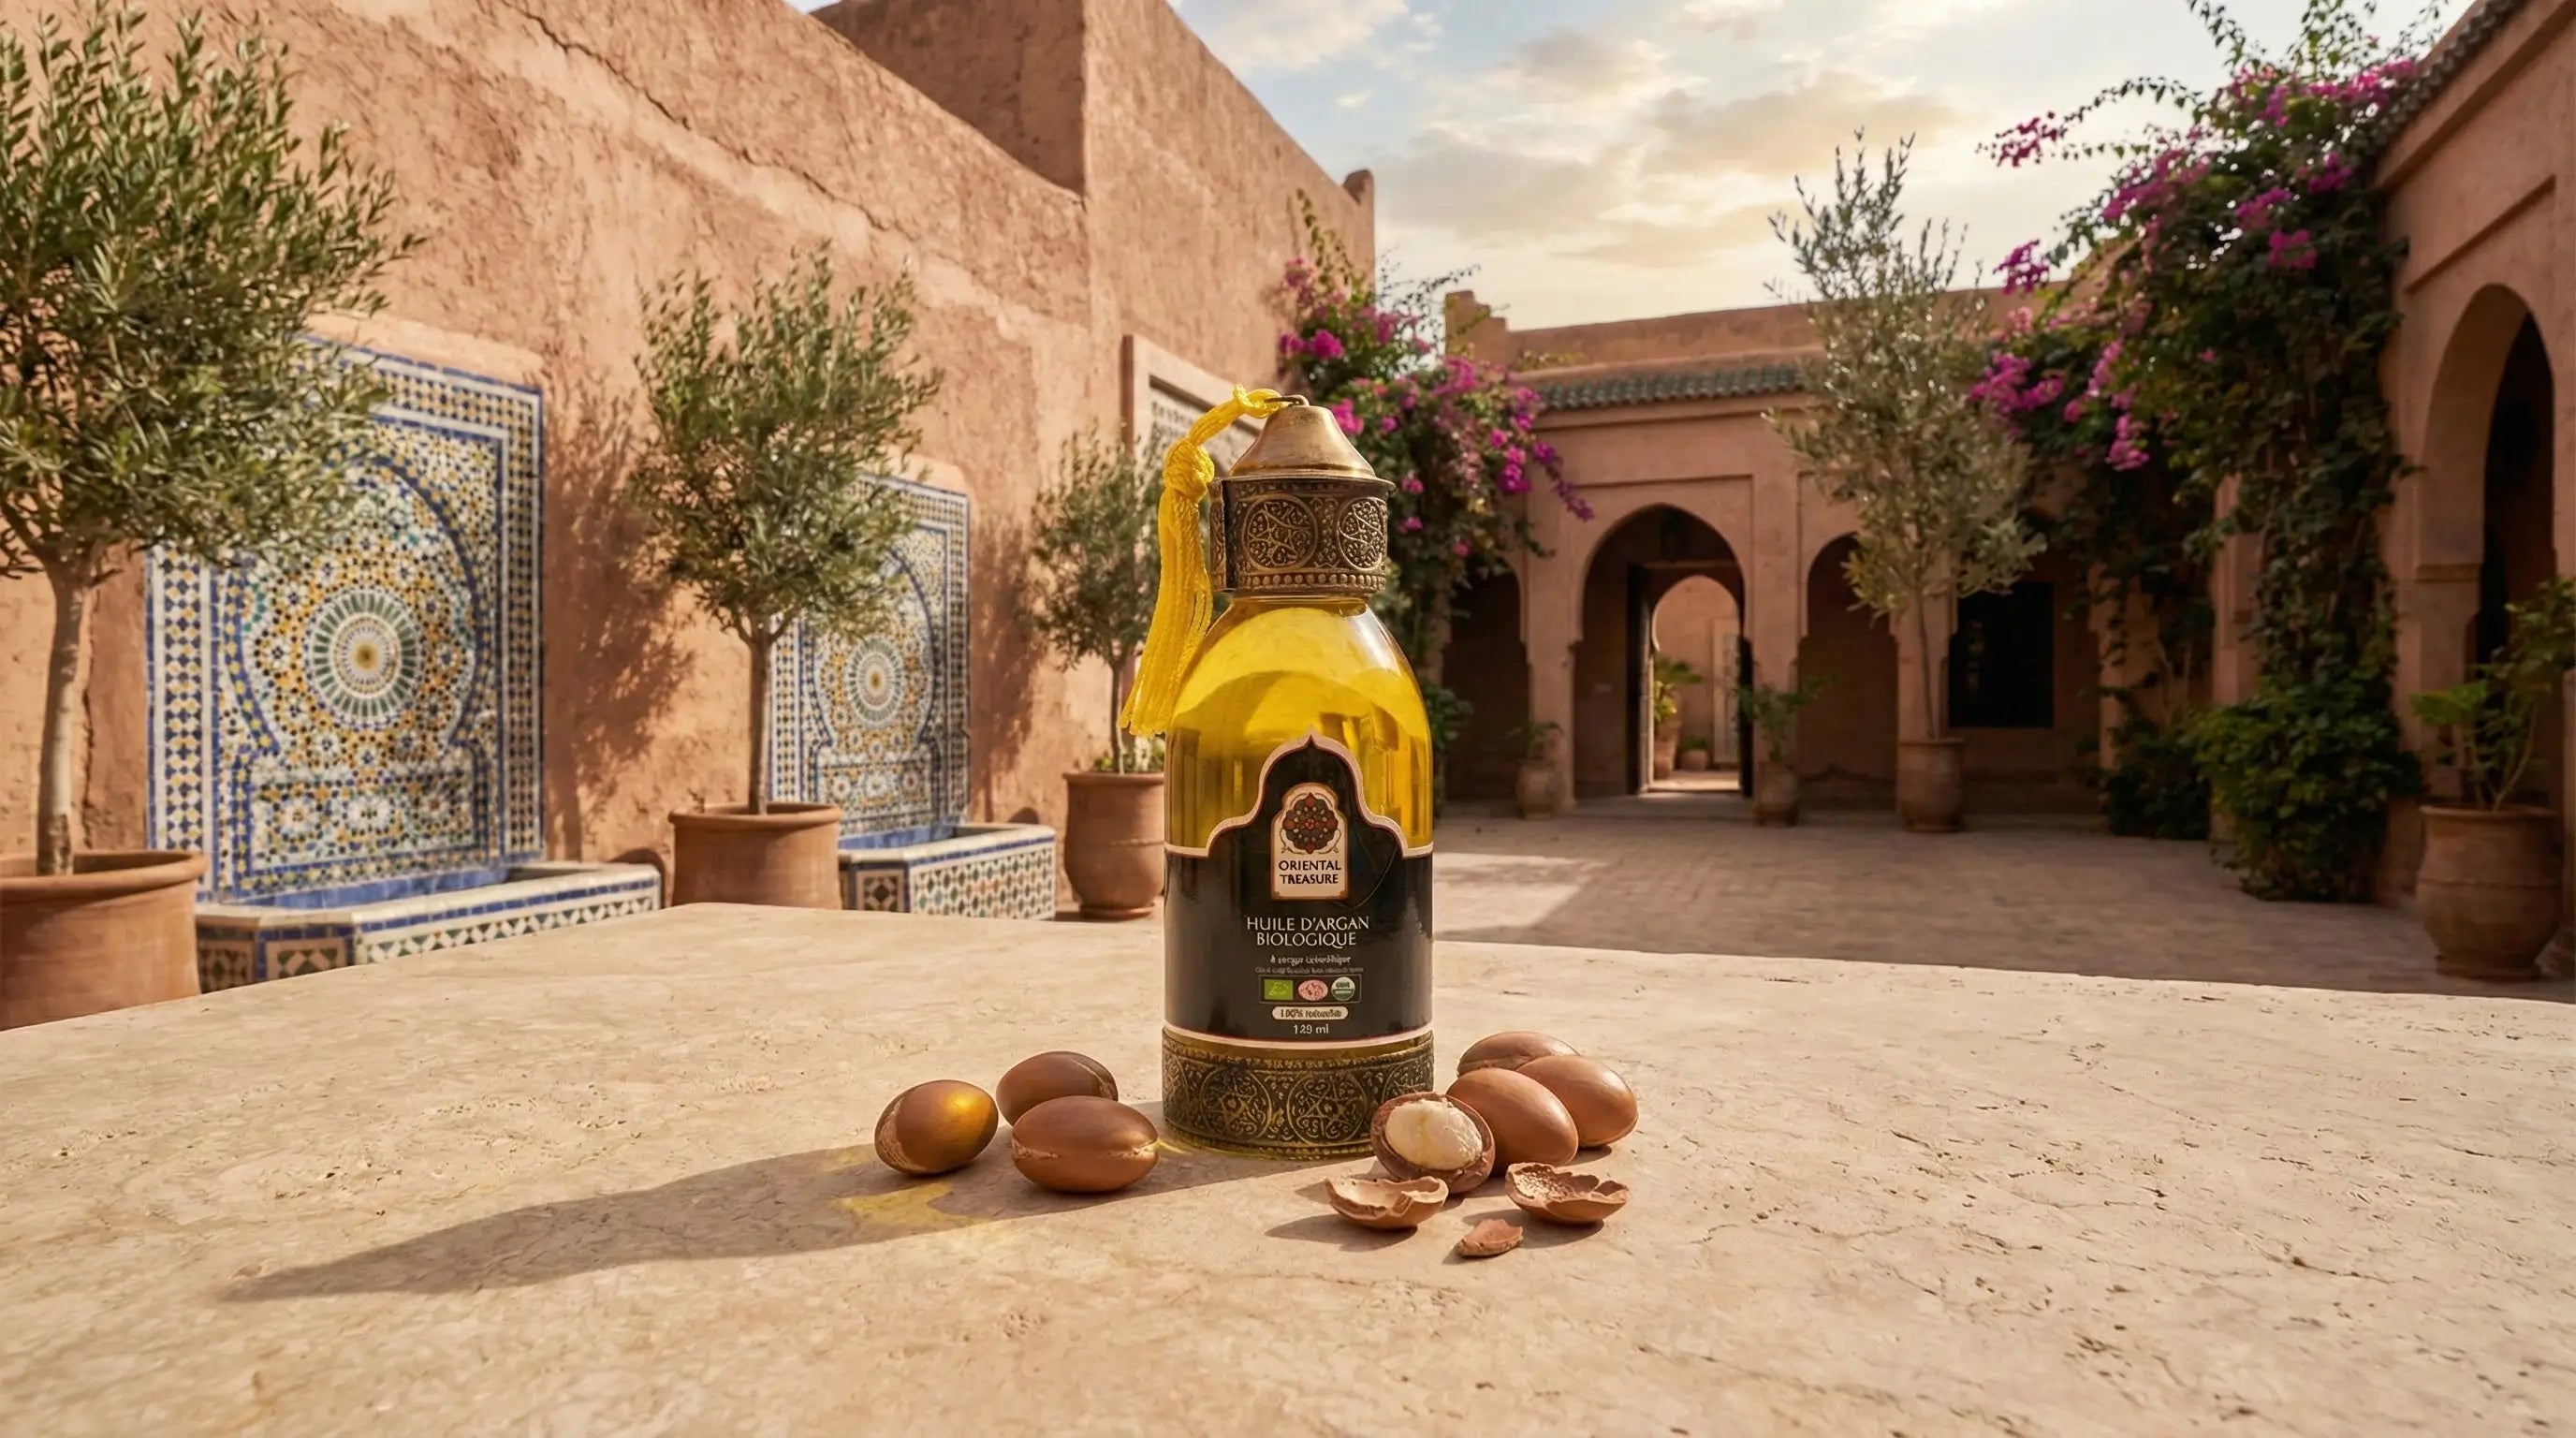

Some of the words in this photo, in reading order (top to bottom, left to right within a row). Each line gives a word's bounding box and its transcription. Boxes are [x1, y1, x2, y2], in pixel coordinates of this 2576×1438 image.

[1278, 859, 1341, 871] ORIENTAL
[1280, 874, 1339, 885] TREASURE
[1247, 917, 1295, 931] HUILE
[1300, 917, 1369, 931] D'ARGAN
[1256, 932, 1356, 948] BIOLOGIQUE
[1315, 1023, 1329, 1034] ml
